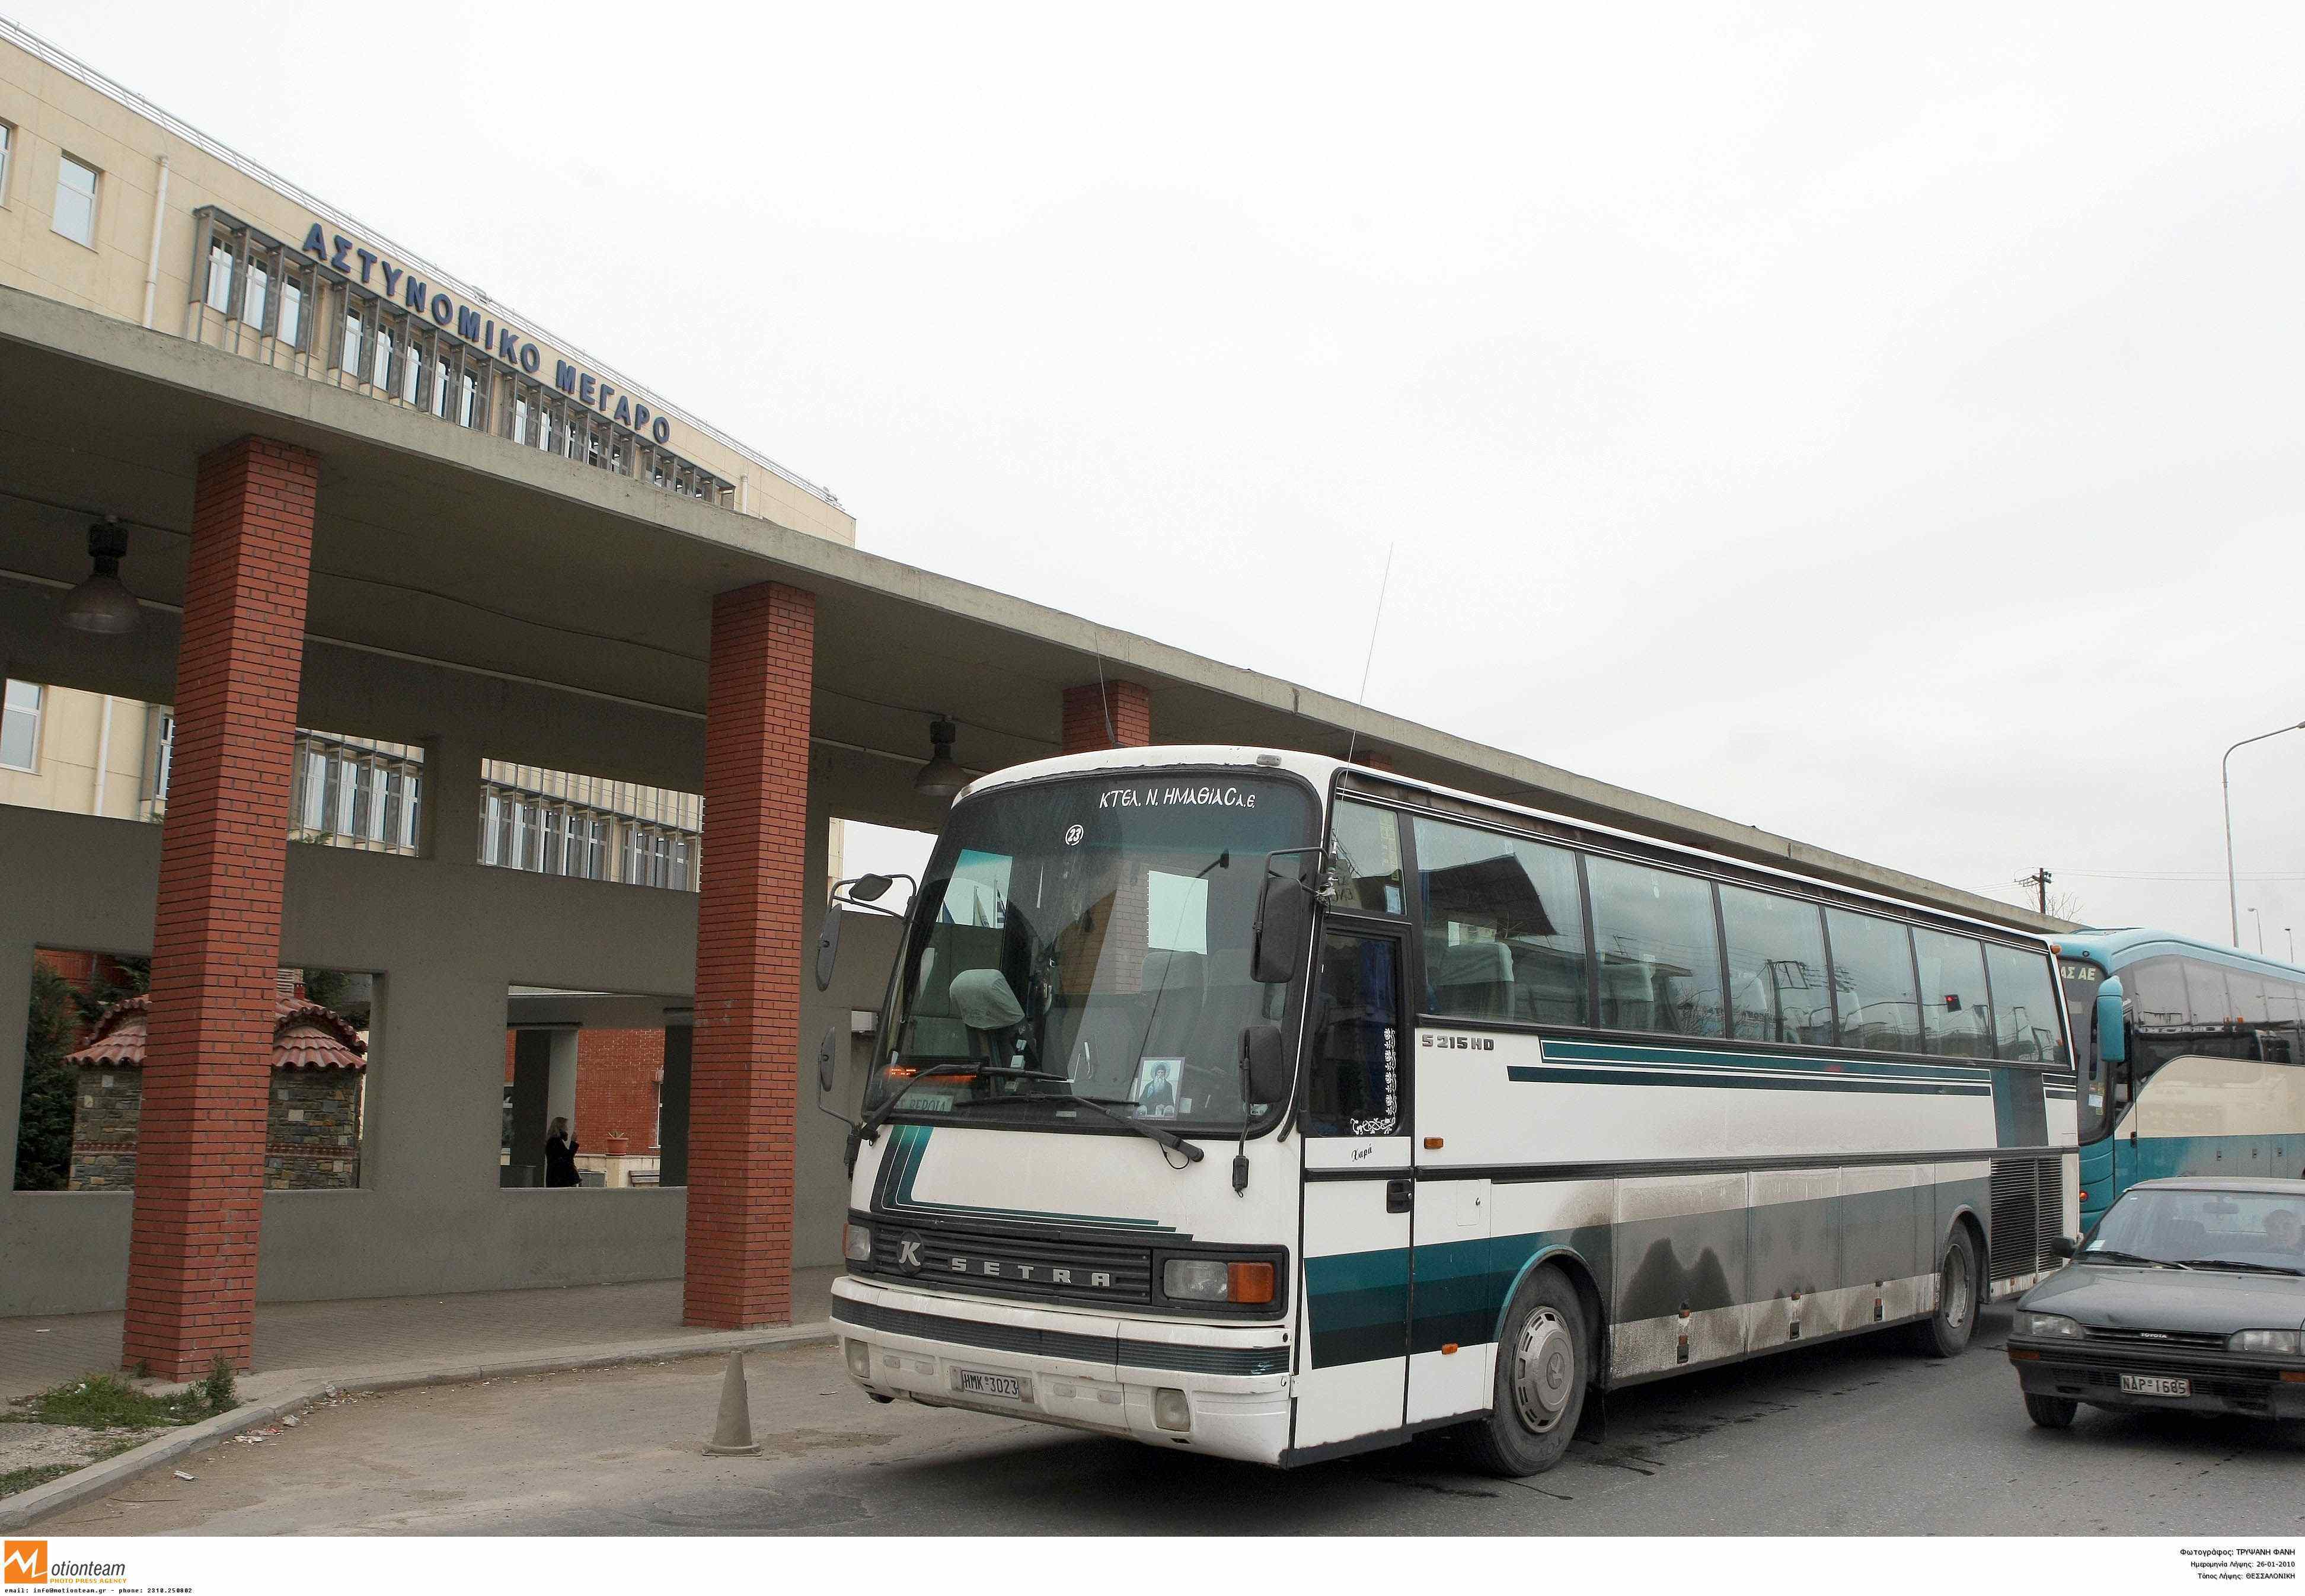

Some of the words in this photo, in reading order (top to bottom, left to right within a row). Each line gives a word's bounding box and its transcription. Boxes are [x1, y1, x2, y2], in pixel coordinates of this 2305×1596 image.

[302, 222, 541, 372] ΑΣΤΥΝΟΜΙΚΟ
[555, 359, 671, 444] ΜΕΓΑΡΟ
[1067, 828, 1081, 842] 23
[2077, 967, 2096, 981] ΑΕ
[1352, 1142, 1372, 1162] Χαρά
[898, 1240, 921, 1267] K
[951, 1257, 1111, 1287] SETRA
